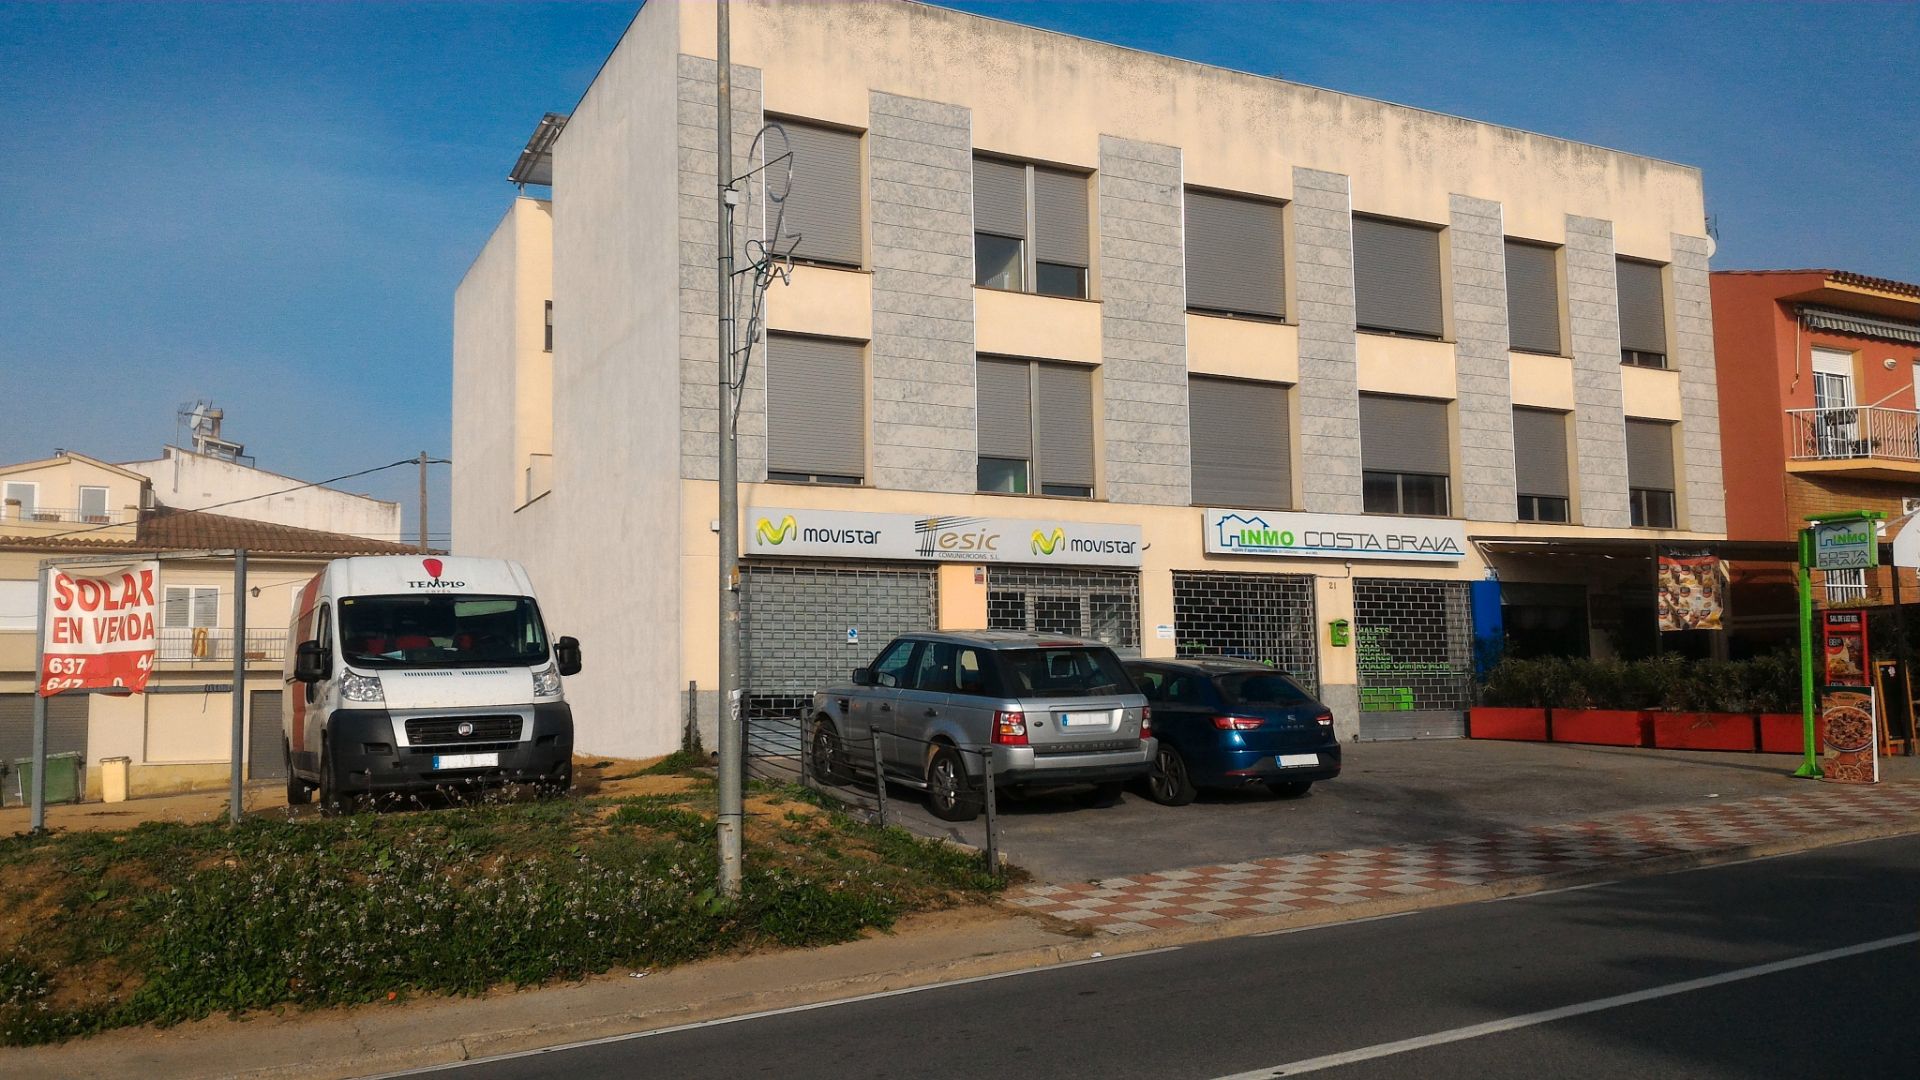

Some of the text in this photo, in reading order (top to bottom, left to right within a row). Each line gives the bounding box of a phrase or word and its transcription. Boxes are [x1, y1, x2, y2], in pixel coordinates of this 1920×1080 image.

[803, 528, 881, 544] movistar
[1240, 529, 1459, 552] INMO COSTA BRAVA
[1833, 533, 1867, 543] INMO
[1070, 539, 1136, 554] movistar
[1819, 550, 1868, 560] COSTA
[54, 570, 154, 611] SOLAR
[1328, 581, 1337, 590] 21
[52, 612, 154, 644] EN VENDA
[49, 657, 86, 674] 637
